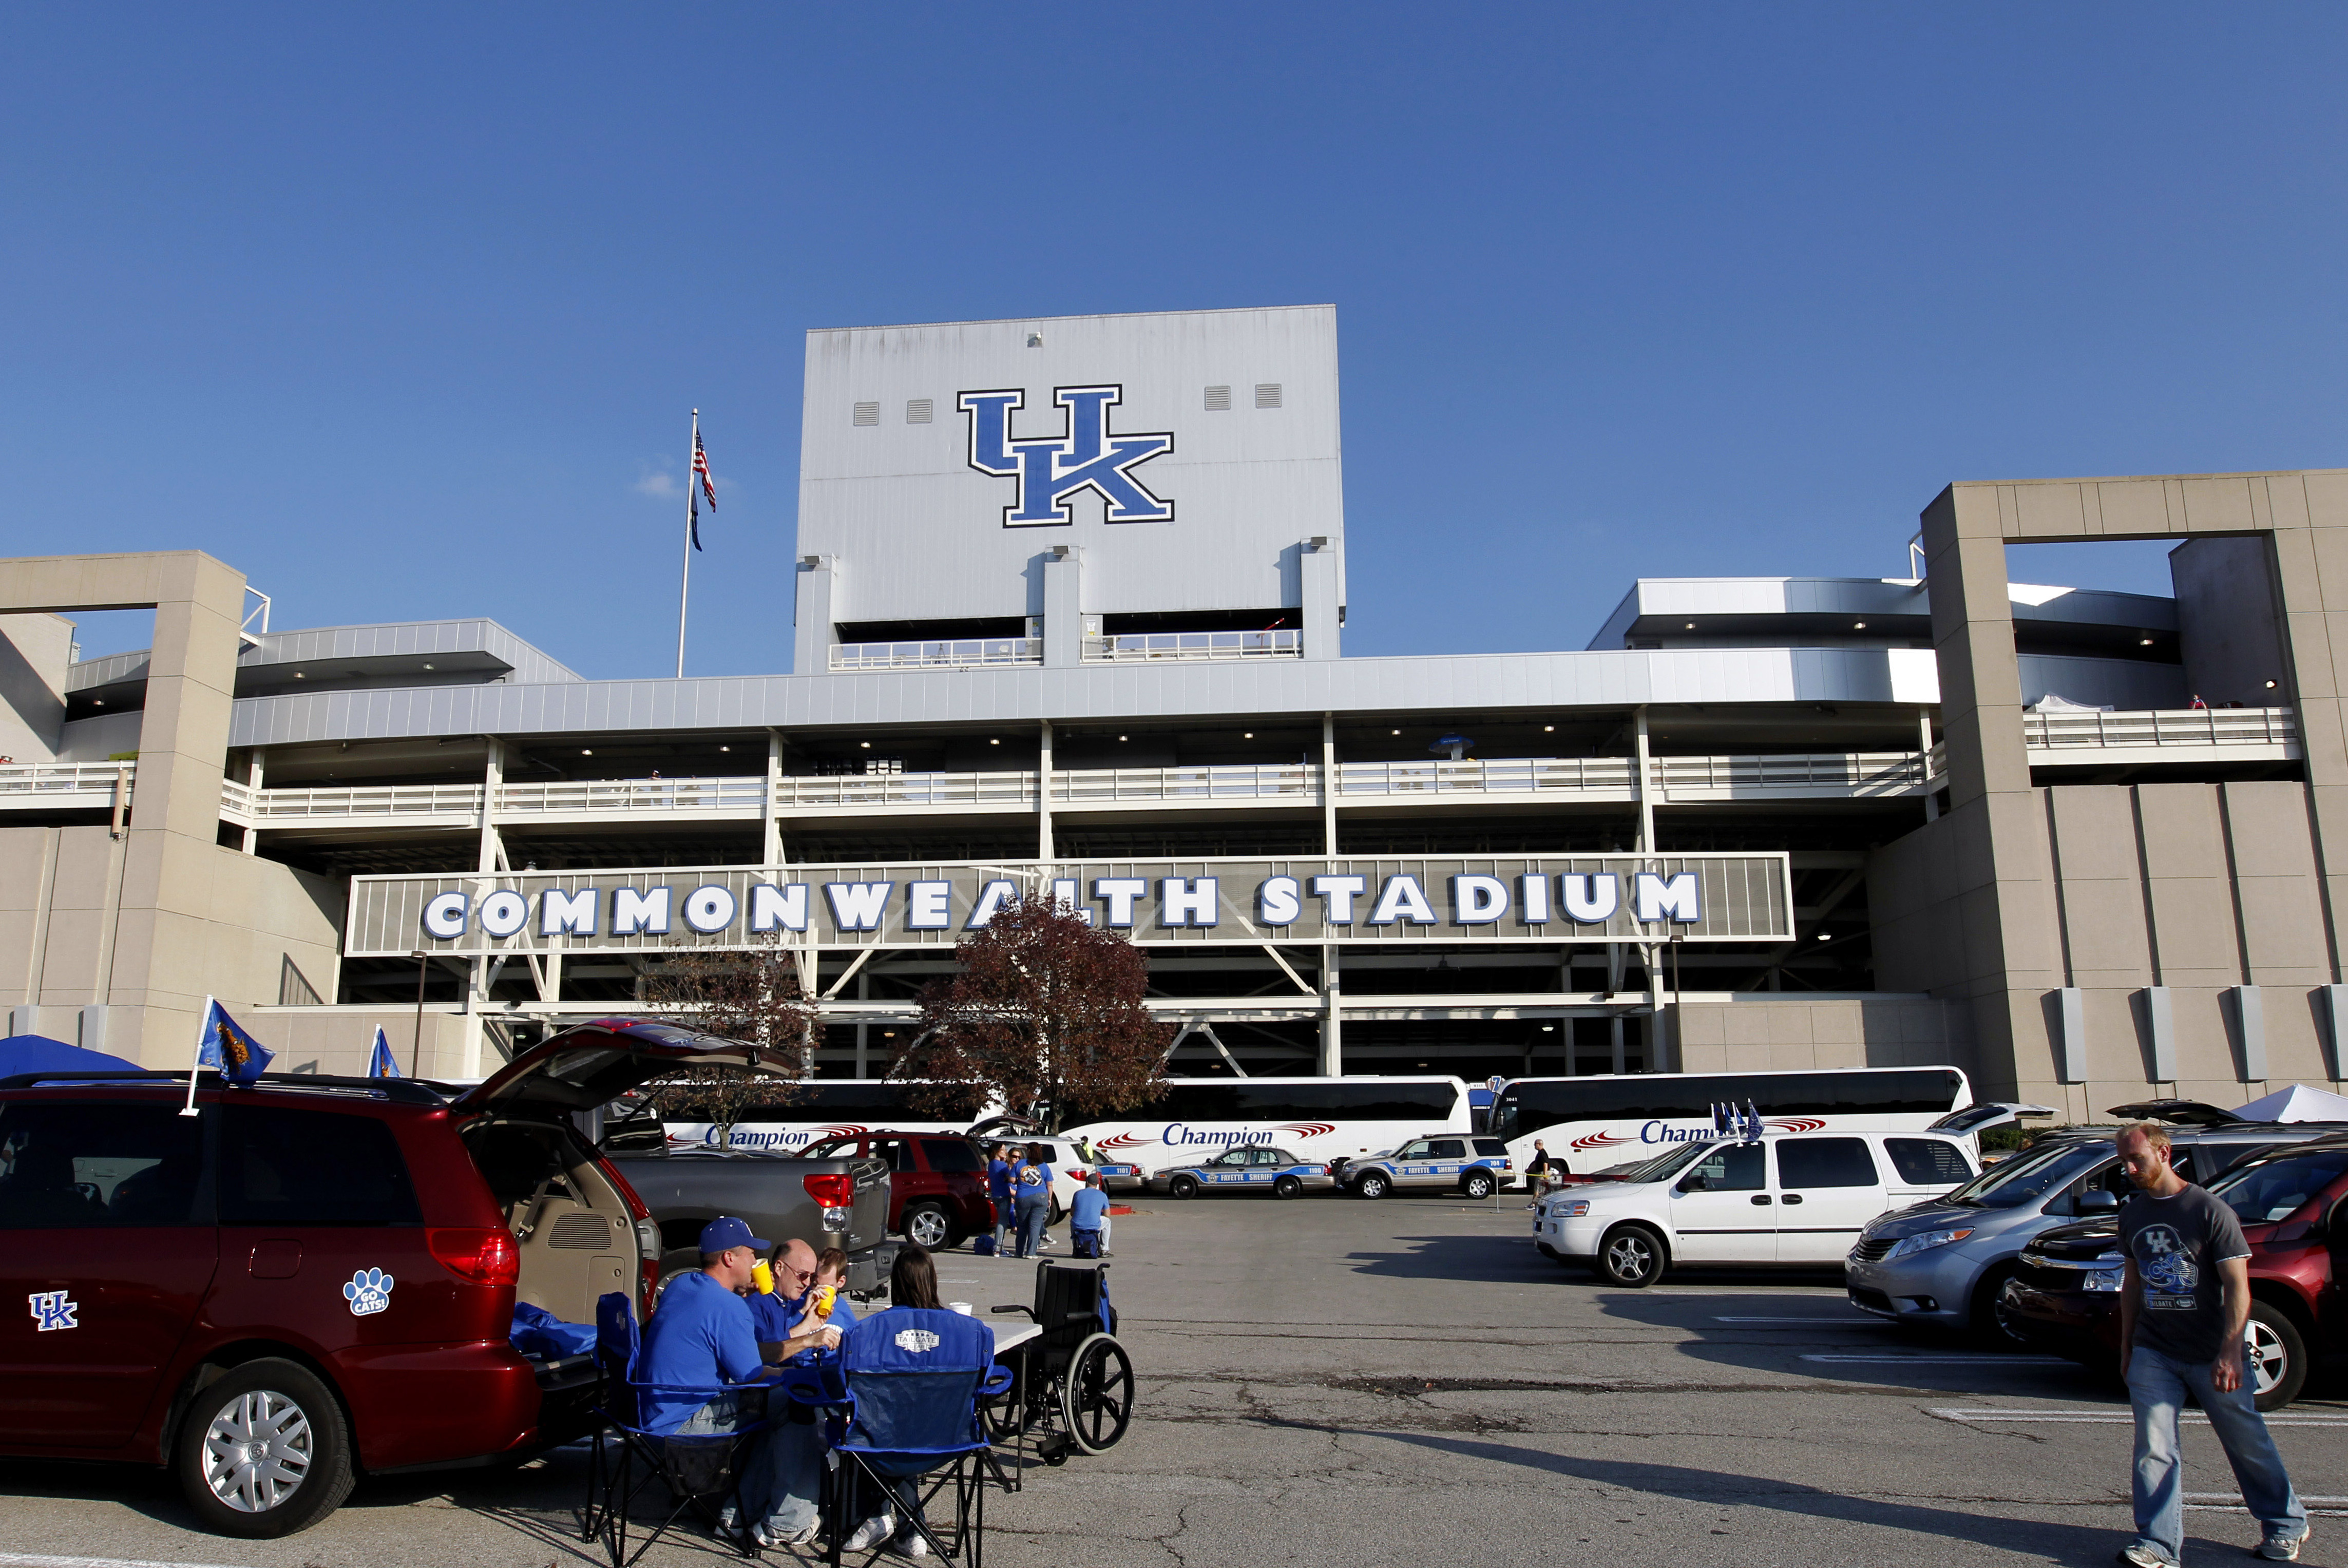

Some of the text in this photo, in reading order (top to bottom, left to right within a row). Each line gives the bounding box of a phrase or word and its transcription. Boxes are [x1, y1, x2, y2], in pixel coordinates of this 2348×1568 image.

[957, 384, 1175, 528] UK
[424, 871, 1700, 938] COMMONWEALTH STADIUM
[1162, 1123, 1273, 1150] Champion
[2145, 1231, 2172, 1253] UK
[354, 1298, 385, 1313] CATS!
[360, 1291, 378, 1302] GO
[29, 1290, 77, 1331] UK
